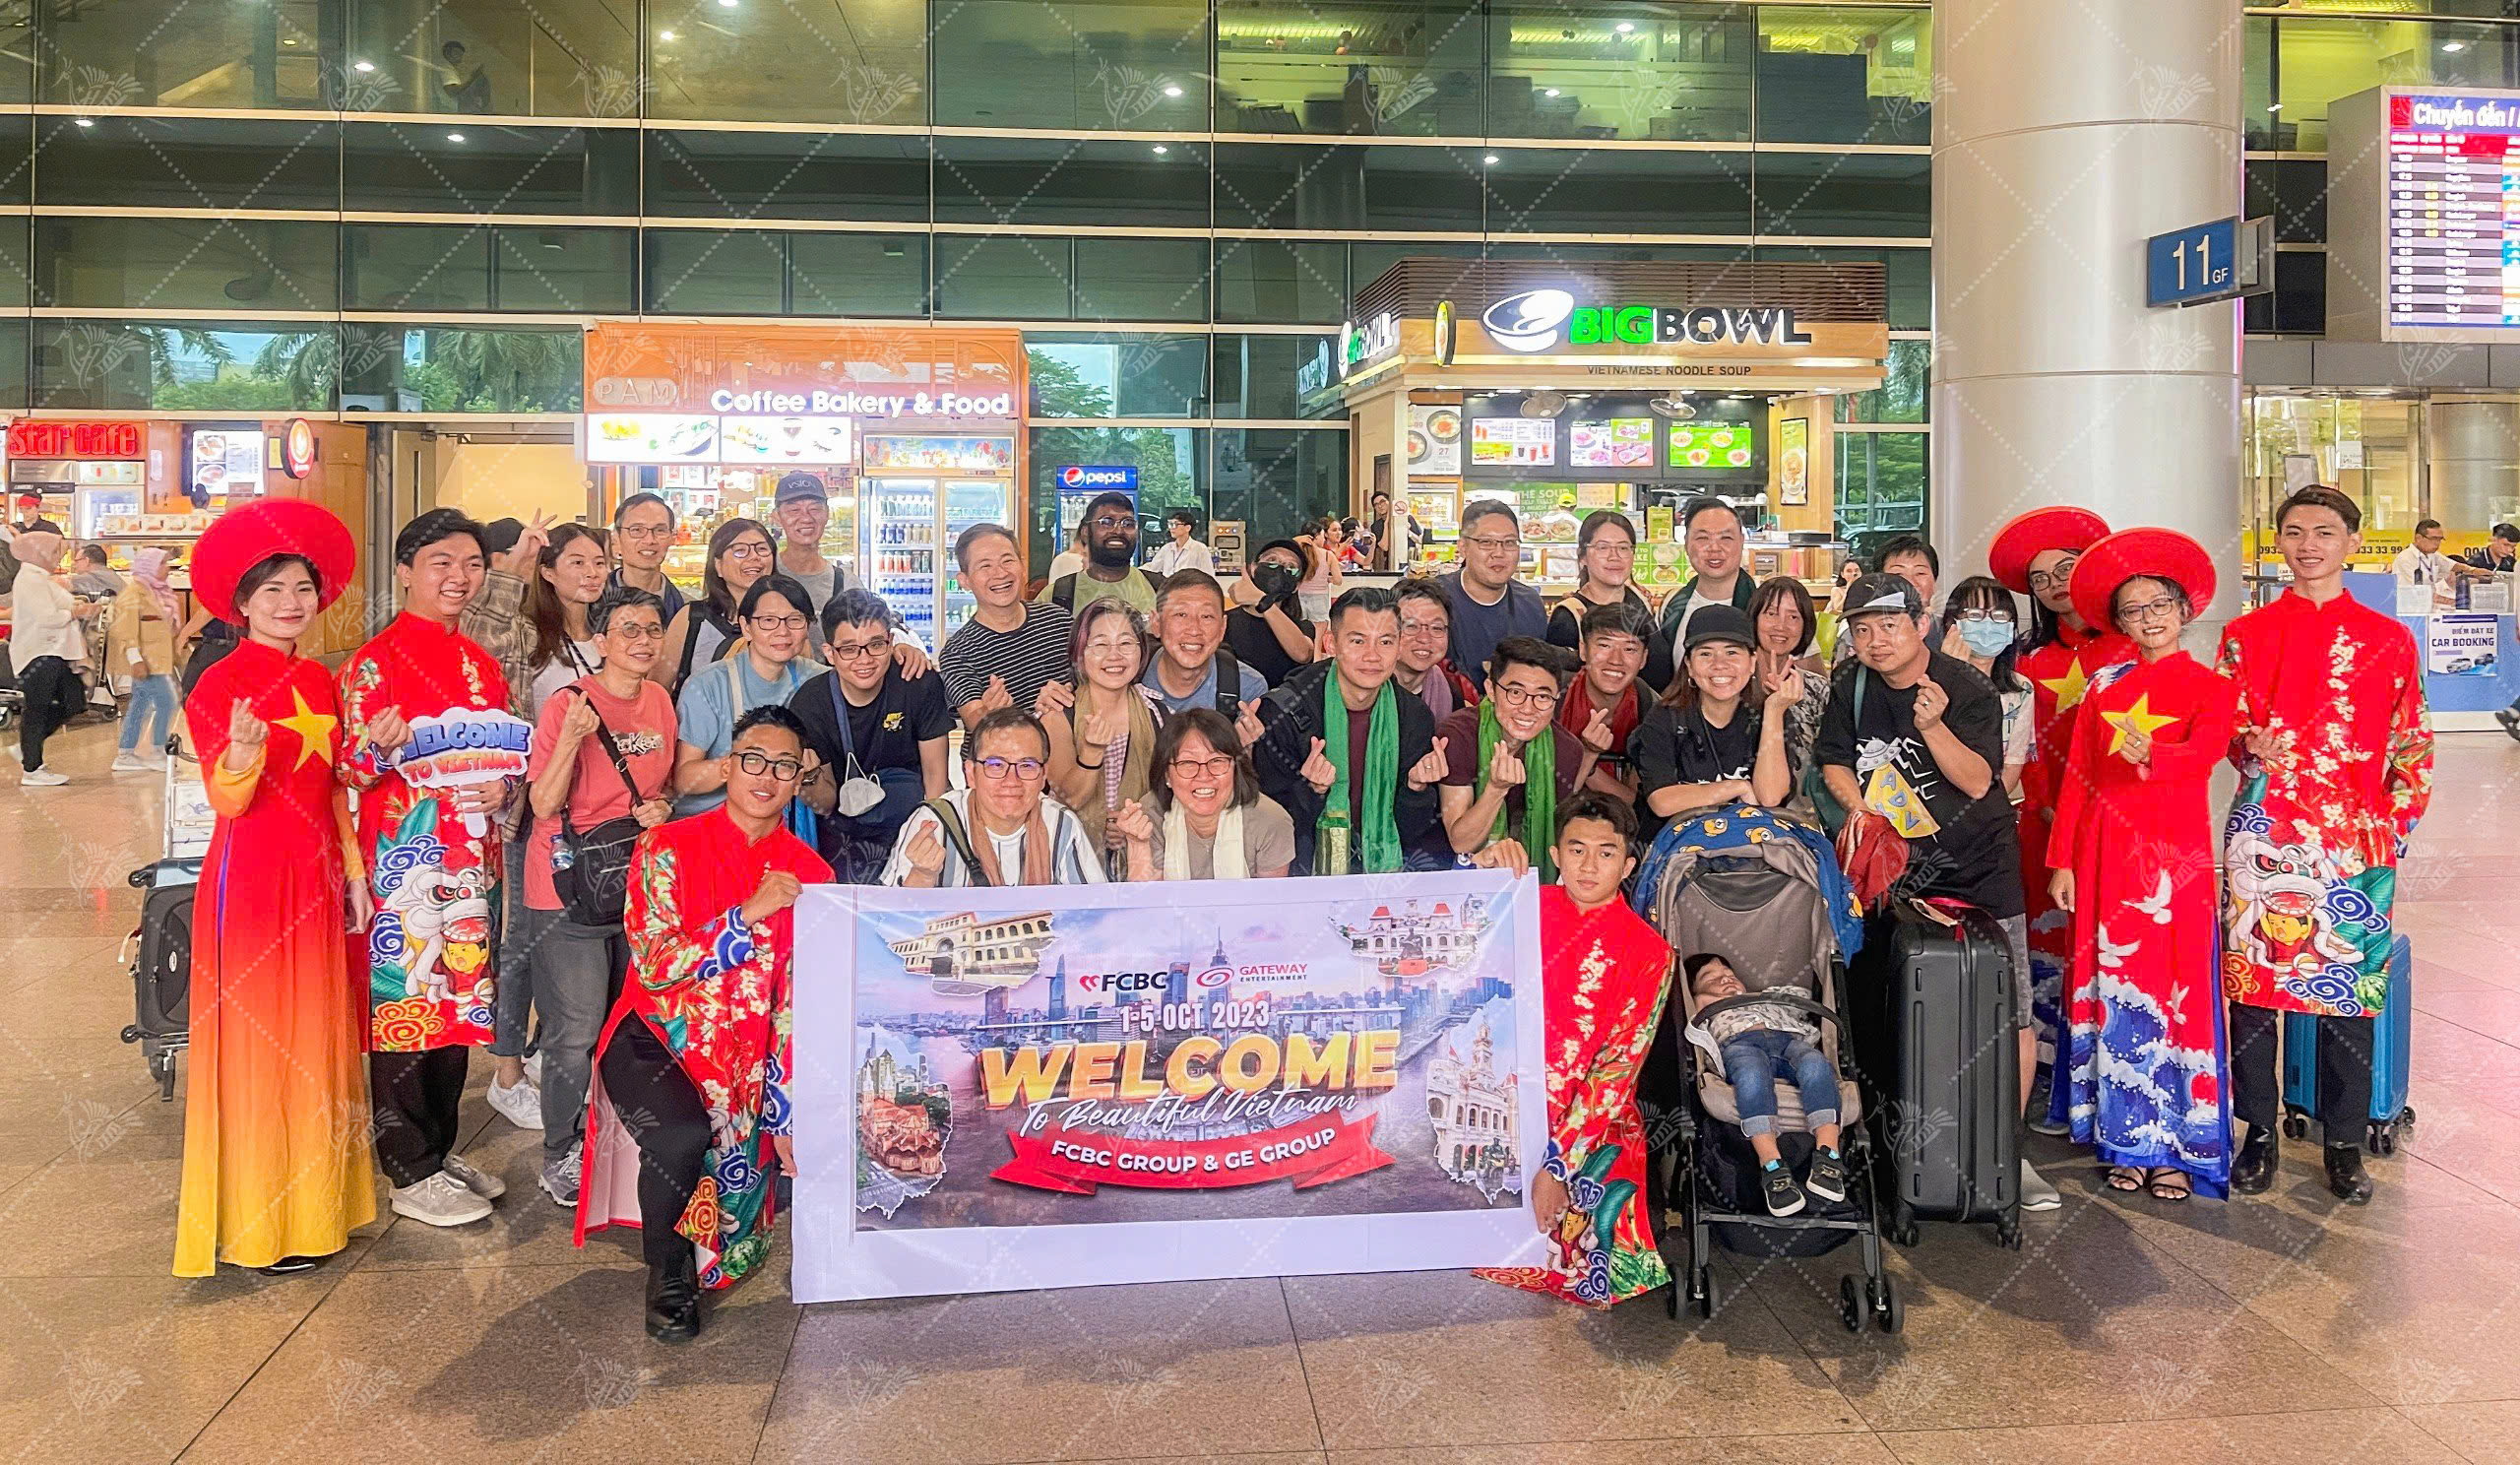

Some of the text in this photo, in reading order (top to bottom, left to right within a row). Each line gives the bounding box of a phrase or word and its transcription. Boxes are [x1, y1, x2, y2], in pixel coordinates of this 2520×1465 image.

[2173, 234, 2210, 290] 11
[2212, 268, 2229, 284] GF
[1587, 365, 1751, 376] VIETNAMESE NOODLE SOUP
[599, 378, 669, 404] PAM
[710, 389, 1010, 418] Coffee Bakery & Food
[1086, 470, 1127, 485] pepsi
[2431, 637, 2494, 647] CAR BOOKING
[405, 761, 433, 783] TO
[1239, 963, 1308, 976] GATEWAY
[1239, 974, 1307, 983] ENTERTAINMENT
[1102, 971, 1167, 992] FCBC
[1163, 1001, 1203, 1031] OCT
[1212, 999, 1270, 1029] 2023
[979, 1029, 1401, 1111] WELCOME
[1019, 1083, 1359, 1138] To Beautiful Vietnam
[1051, 1127, 1337, 1174] FCBC GROUP & GE GROUP
